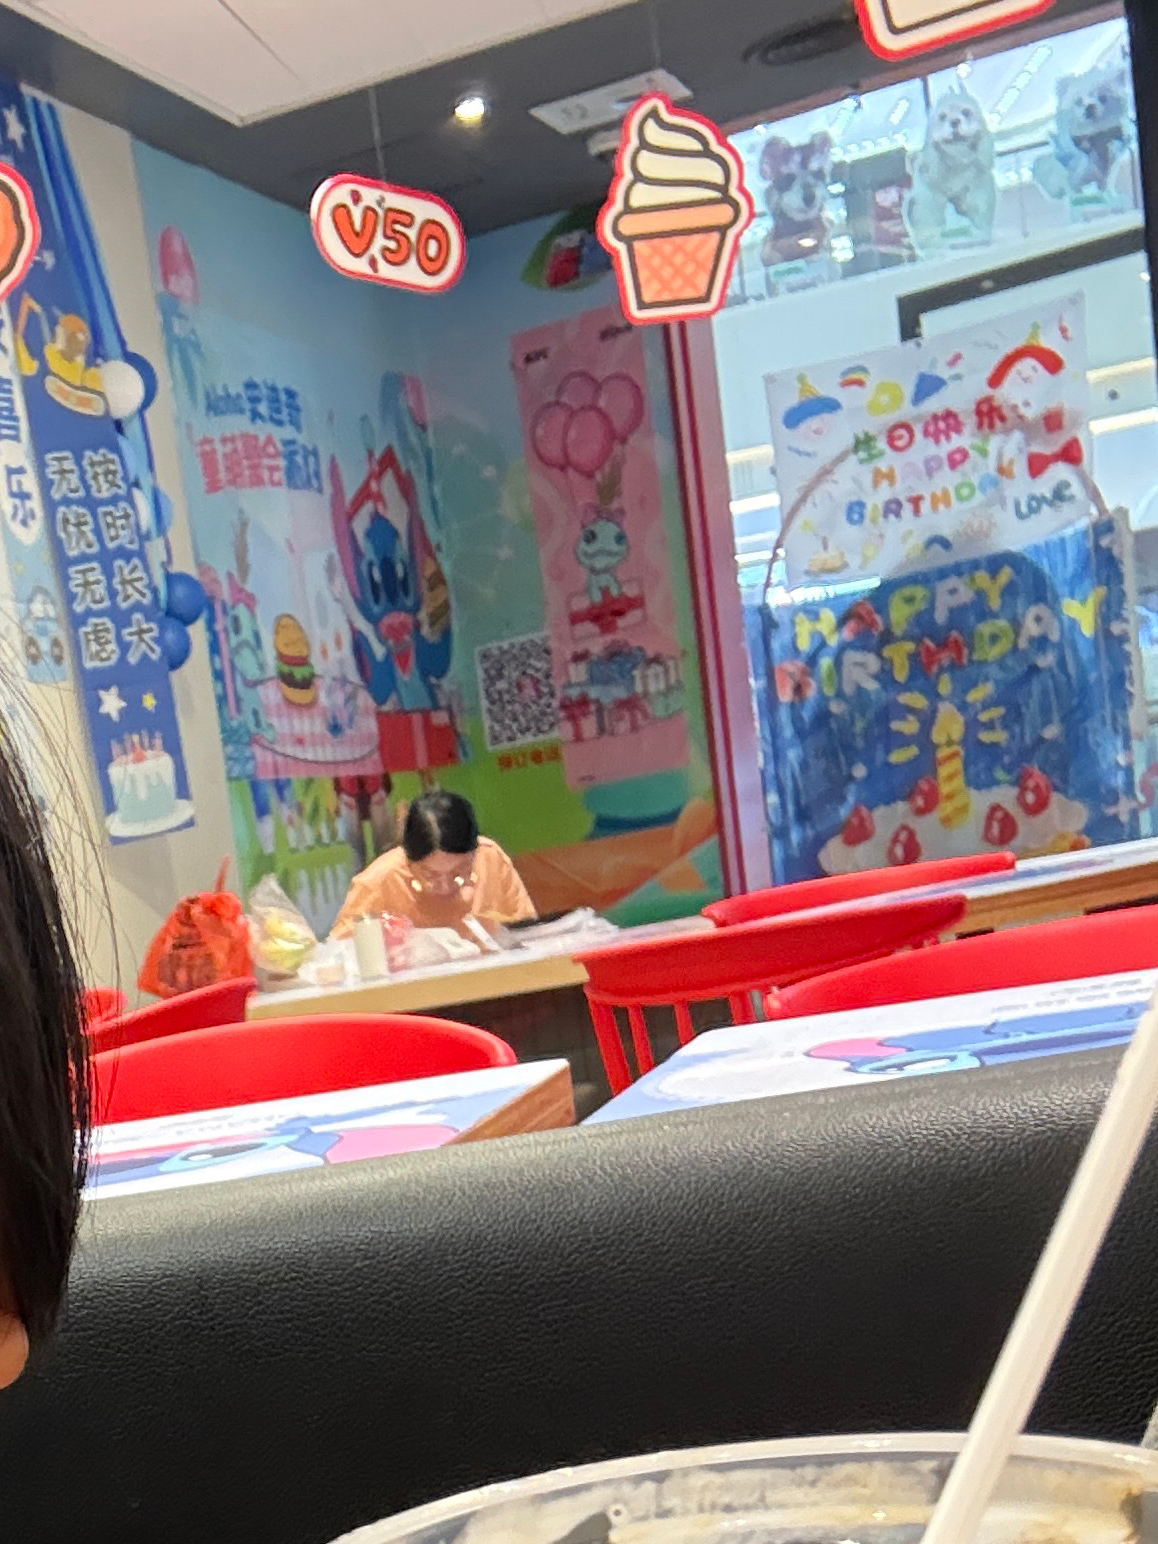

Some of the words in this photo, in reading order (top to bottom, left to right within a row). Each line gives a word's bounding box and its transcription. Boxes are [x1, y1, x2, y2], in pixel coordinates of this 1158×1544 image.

[332, 203, 451, 276] V50
[852, 395, 1007, 464] 生日快乐
[871, 437, 990, 491] HAPPY
[45, 451, 119, 668] 无忧无虑
[83, 449, 161, 665] 按时长大
[774, 585, 1108, 704] BIRTHDAY
[795, 566, 1014, 653] HAPPY
